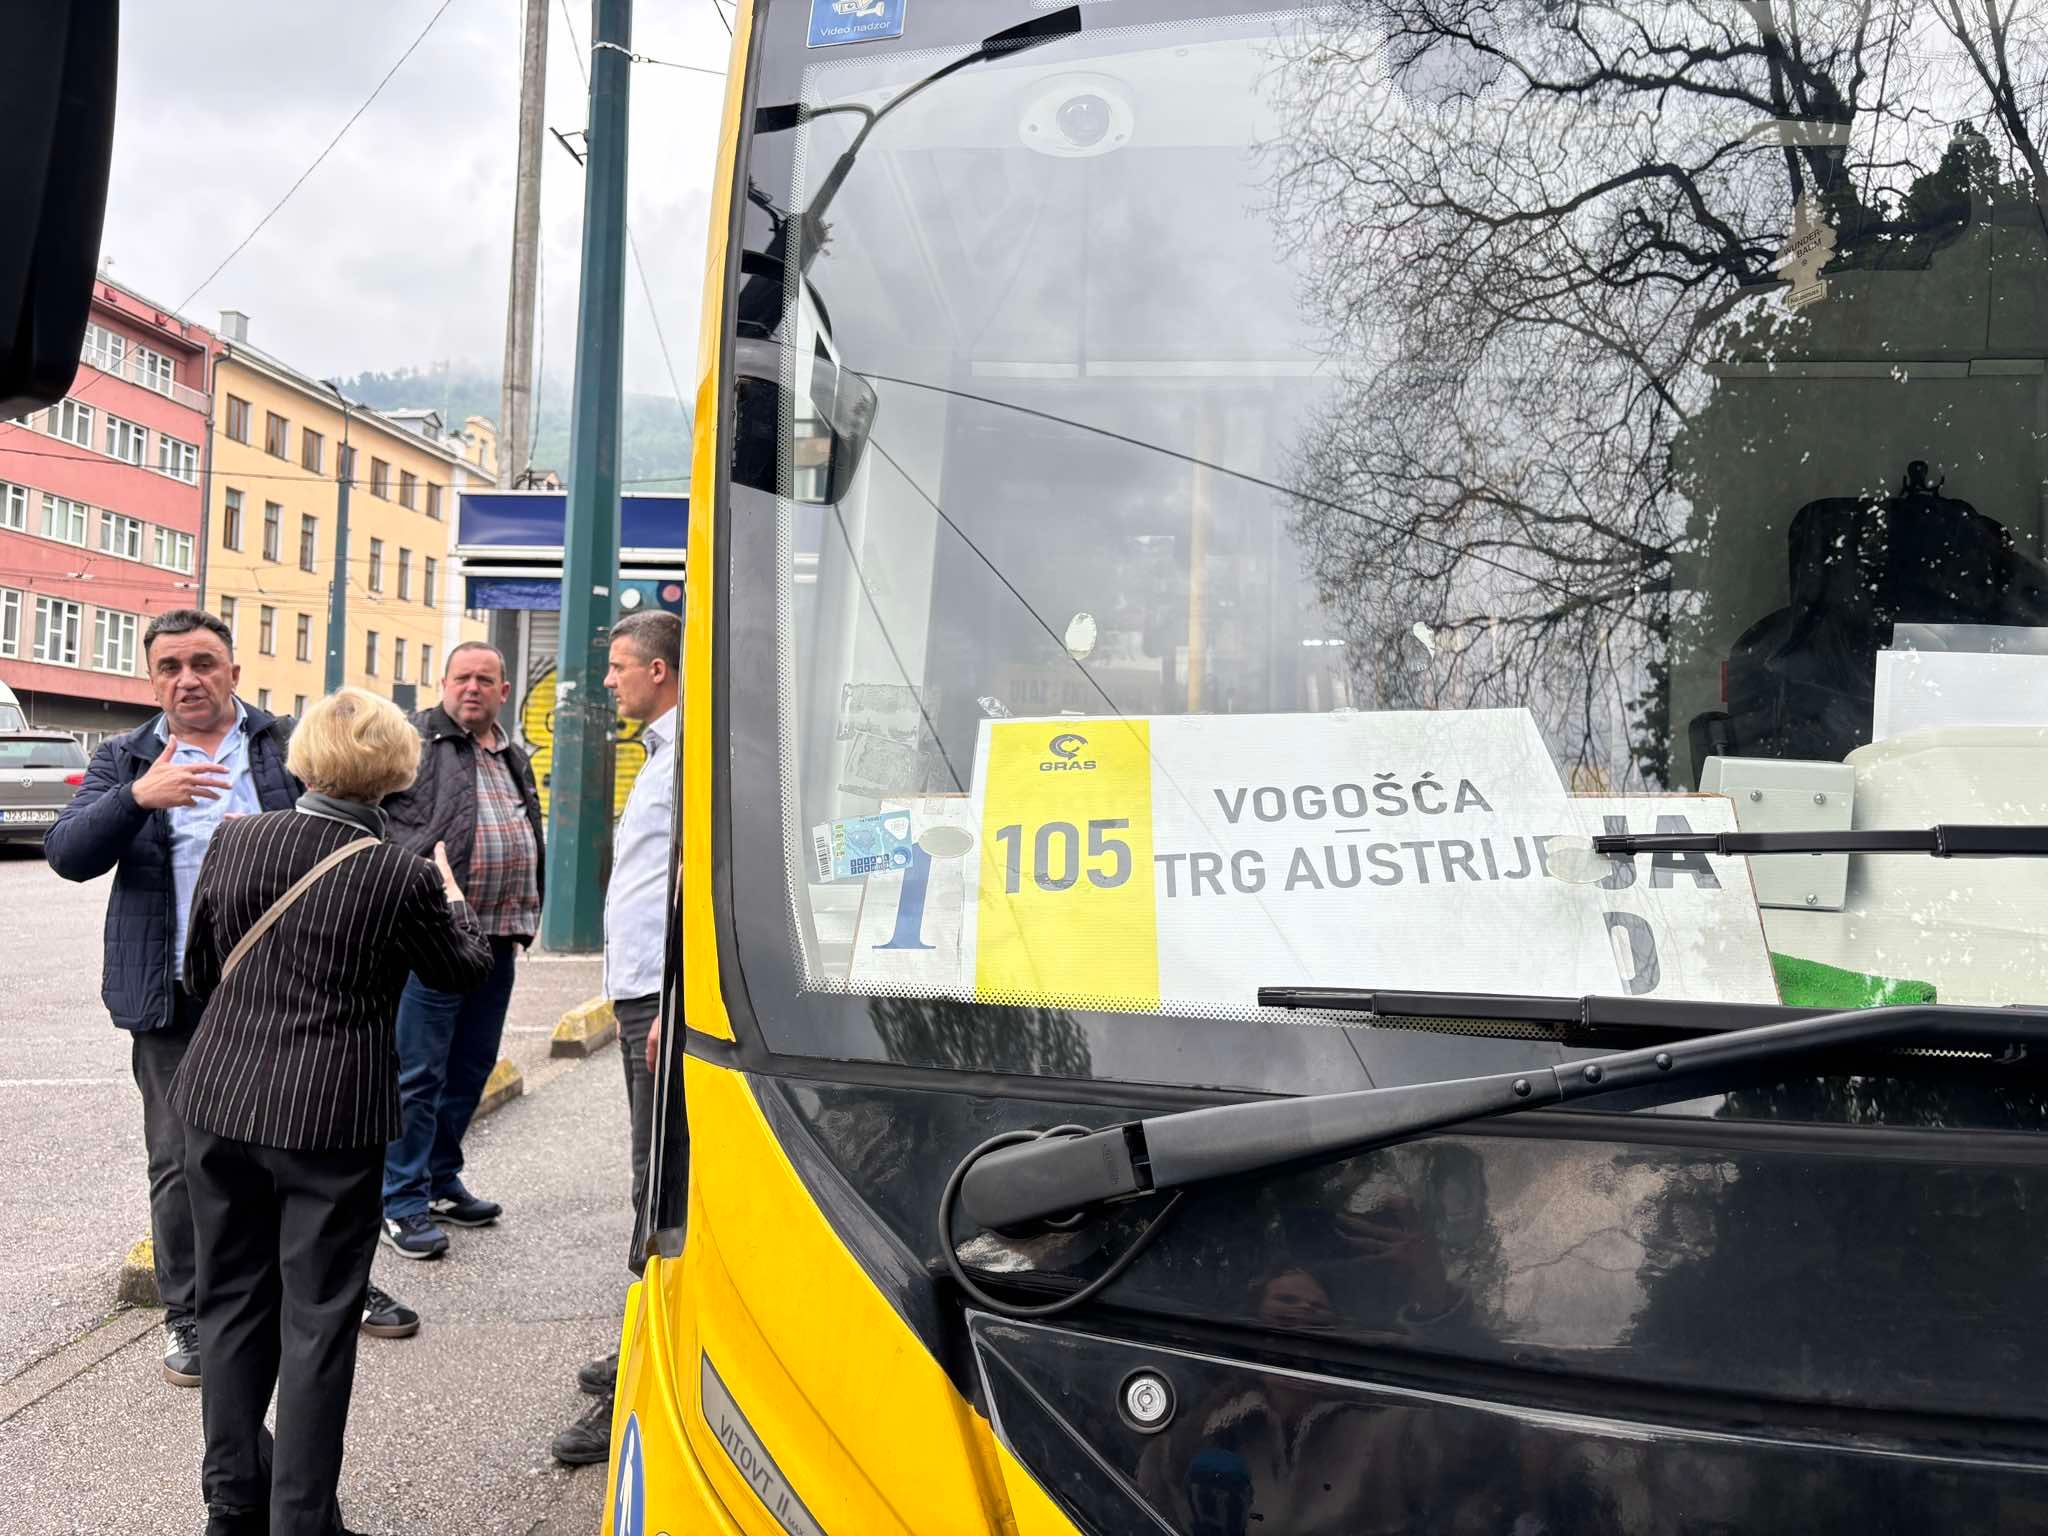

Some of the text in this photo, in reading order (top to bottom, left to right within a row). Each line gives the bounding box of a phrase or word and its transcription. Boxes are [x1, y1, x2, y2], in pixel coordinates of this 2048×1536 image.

[820, 21, 891, 36] Video nadzor
[1039, 760, 1097, 772] GRAS
[1214, 771, 1494, 824] VOGOŠĆA
[995, 818, 1132, 894] 105
[1154, 849, 1266, 898] TRG
[720, 1413, 774, 1495] VITOVT
